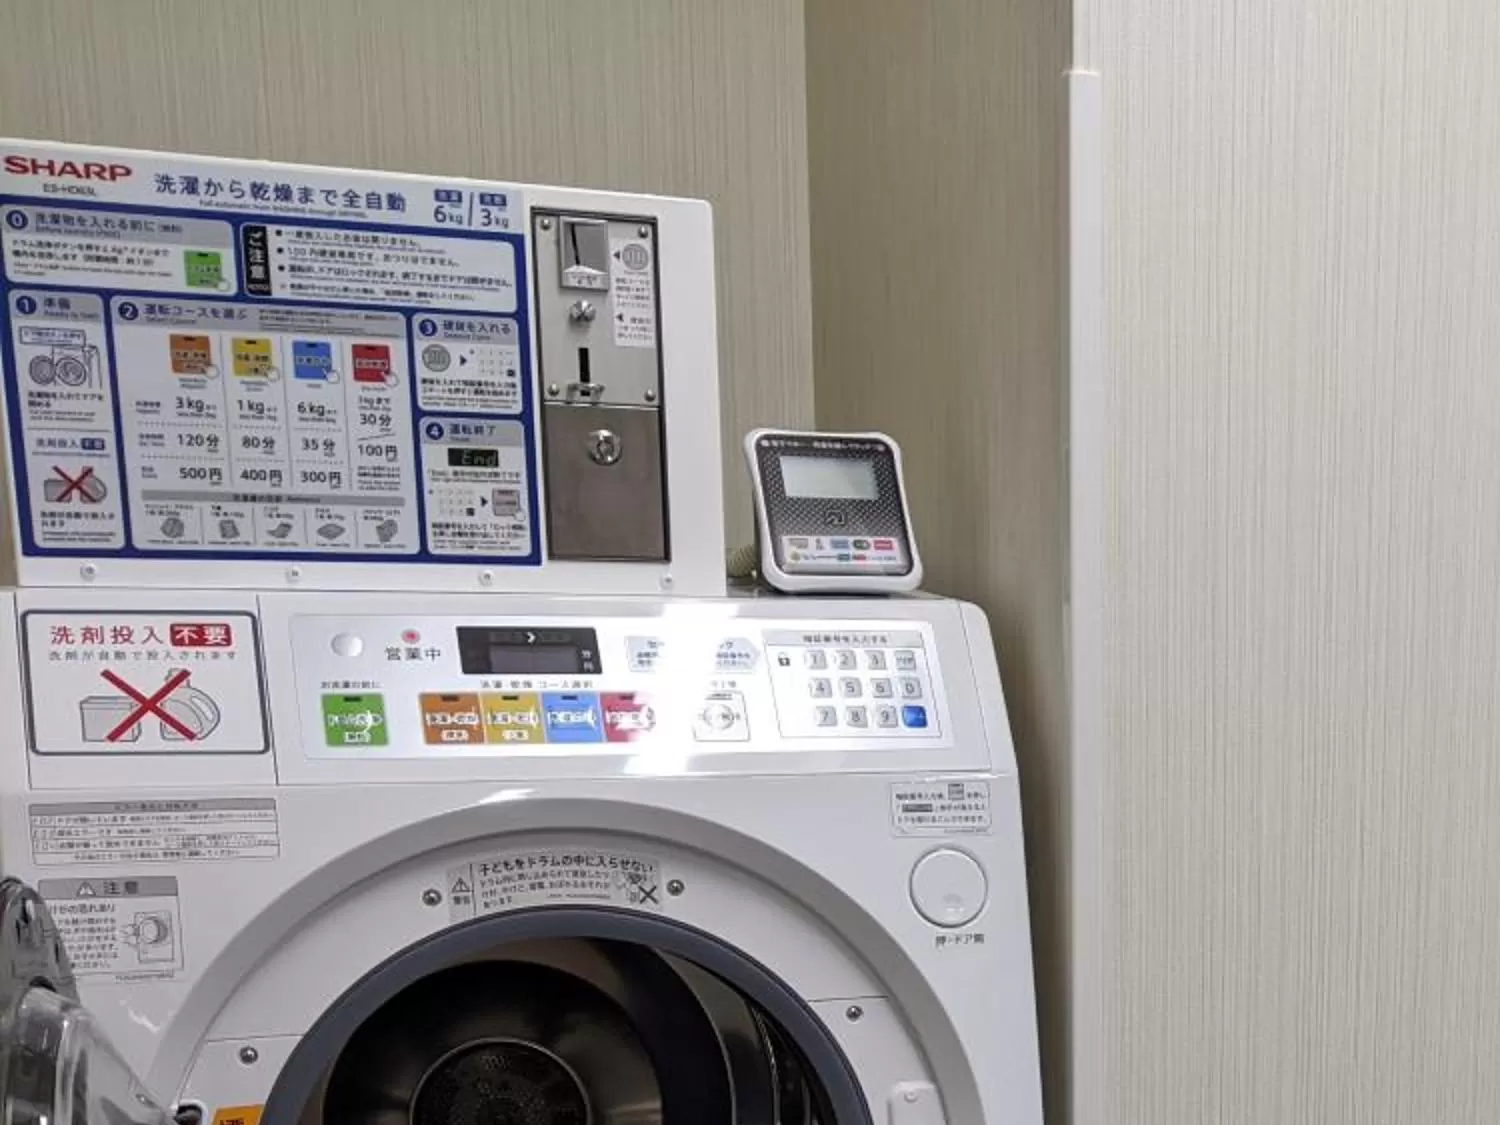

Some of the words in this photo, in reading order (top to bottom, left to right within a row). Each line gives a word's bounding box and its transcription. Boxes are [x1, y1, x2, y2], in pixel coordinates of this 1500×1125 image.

[4, 155, 132, 182] SHARP
[154, 172, 408, 214] 洗濯から乾燥まで全自動
[175, 397, 205, 415] 3kg
[237, 399, 265, 418] 1kg
[297, 403, 326, 418] 6kg
[359, 412, 393, 427] 30分
[178, 432, 219, 449] 120分
[242, 435, 275, 450] 80分
[302, 437, 336, 452] 35分
[358, 443, 398, 460] 100円
[179, 466, 223, 482] 500円
[240, 468, 283, 484] 400円
[301, 470, 342, 486] 300円
[50, 624, 165, 646] 洗剤投入
[174, 625, 231, 646] 不要
[385, 646, 441, 661] 営業中
[480, 855, 654, 876] 子どもをドラムの中に入らせない
